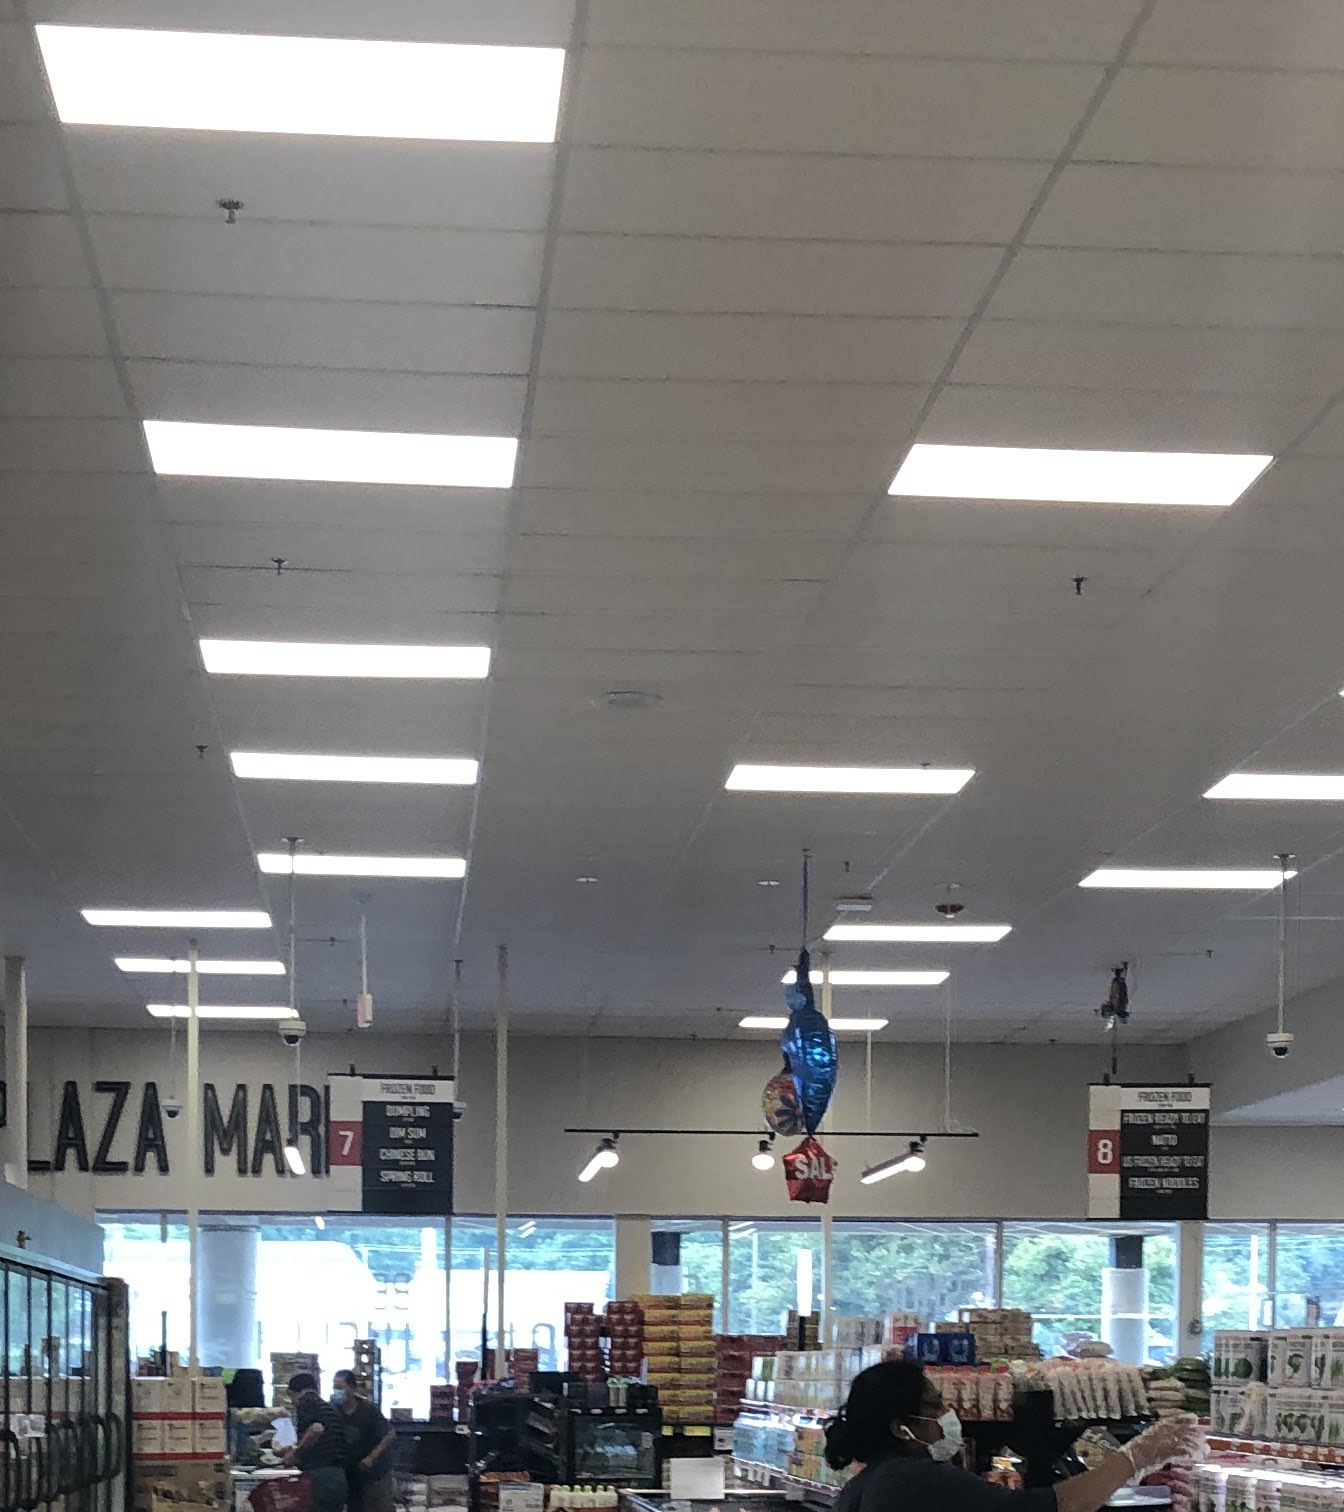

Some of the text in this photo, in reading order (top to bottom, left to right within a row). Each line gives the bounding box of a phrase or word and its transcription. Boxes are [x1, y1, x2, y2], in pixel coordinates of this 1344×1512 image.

[203, 1082, 332, 1177] MAR
[338, 1130, 355, 1156] 7
[1097, 1138, 1113, 1165] 8
